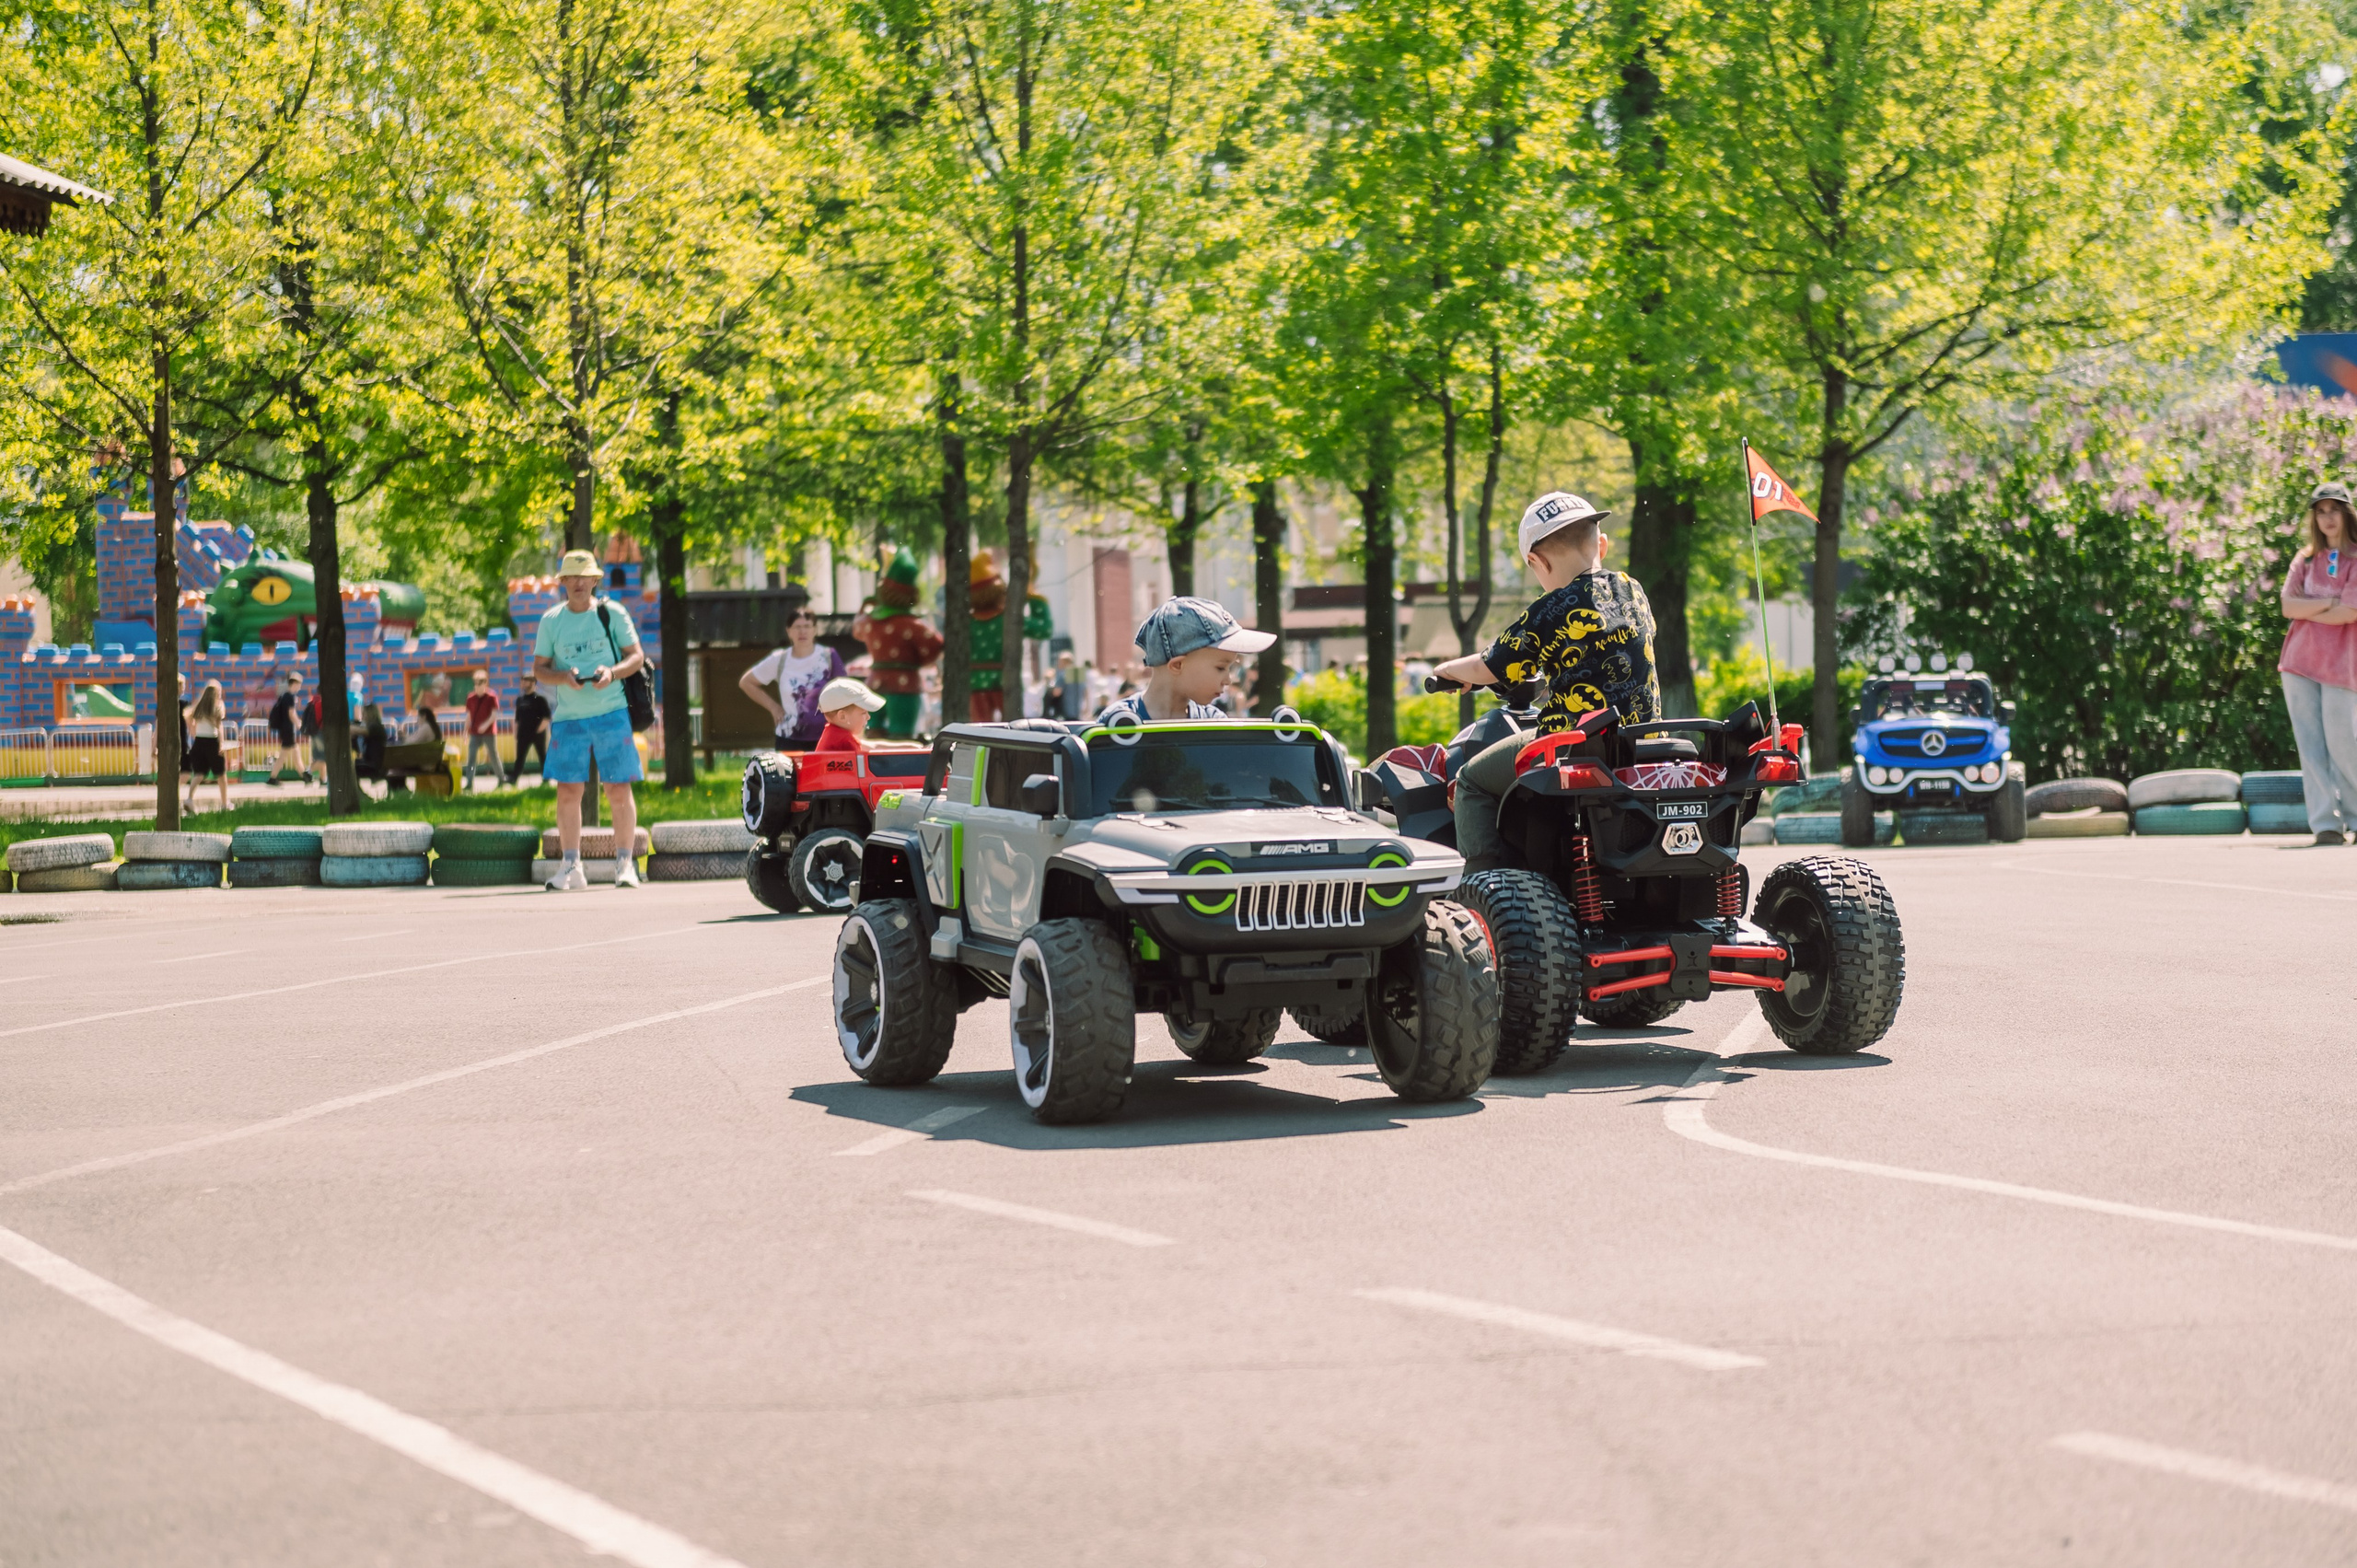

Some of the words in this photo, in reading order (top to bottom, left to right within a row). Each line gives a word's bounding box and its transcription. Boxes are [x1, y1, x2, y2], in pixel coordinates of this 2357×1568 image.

[1753, 471, 1782, 501] 01
[1662, 805, 1702, 817] JM-902
[1281, 842, 1329, 854] AMG
